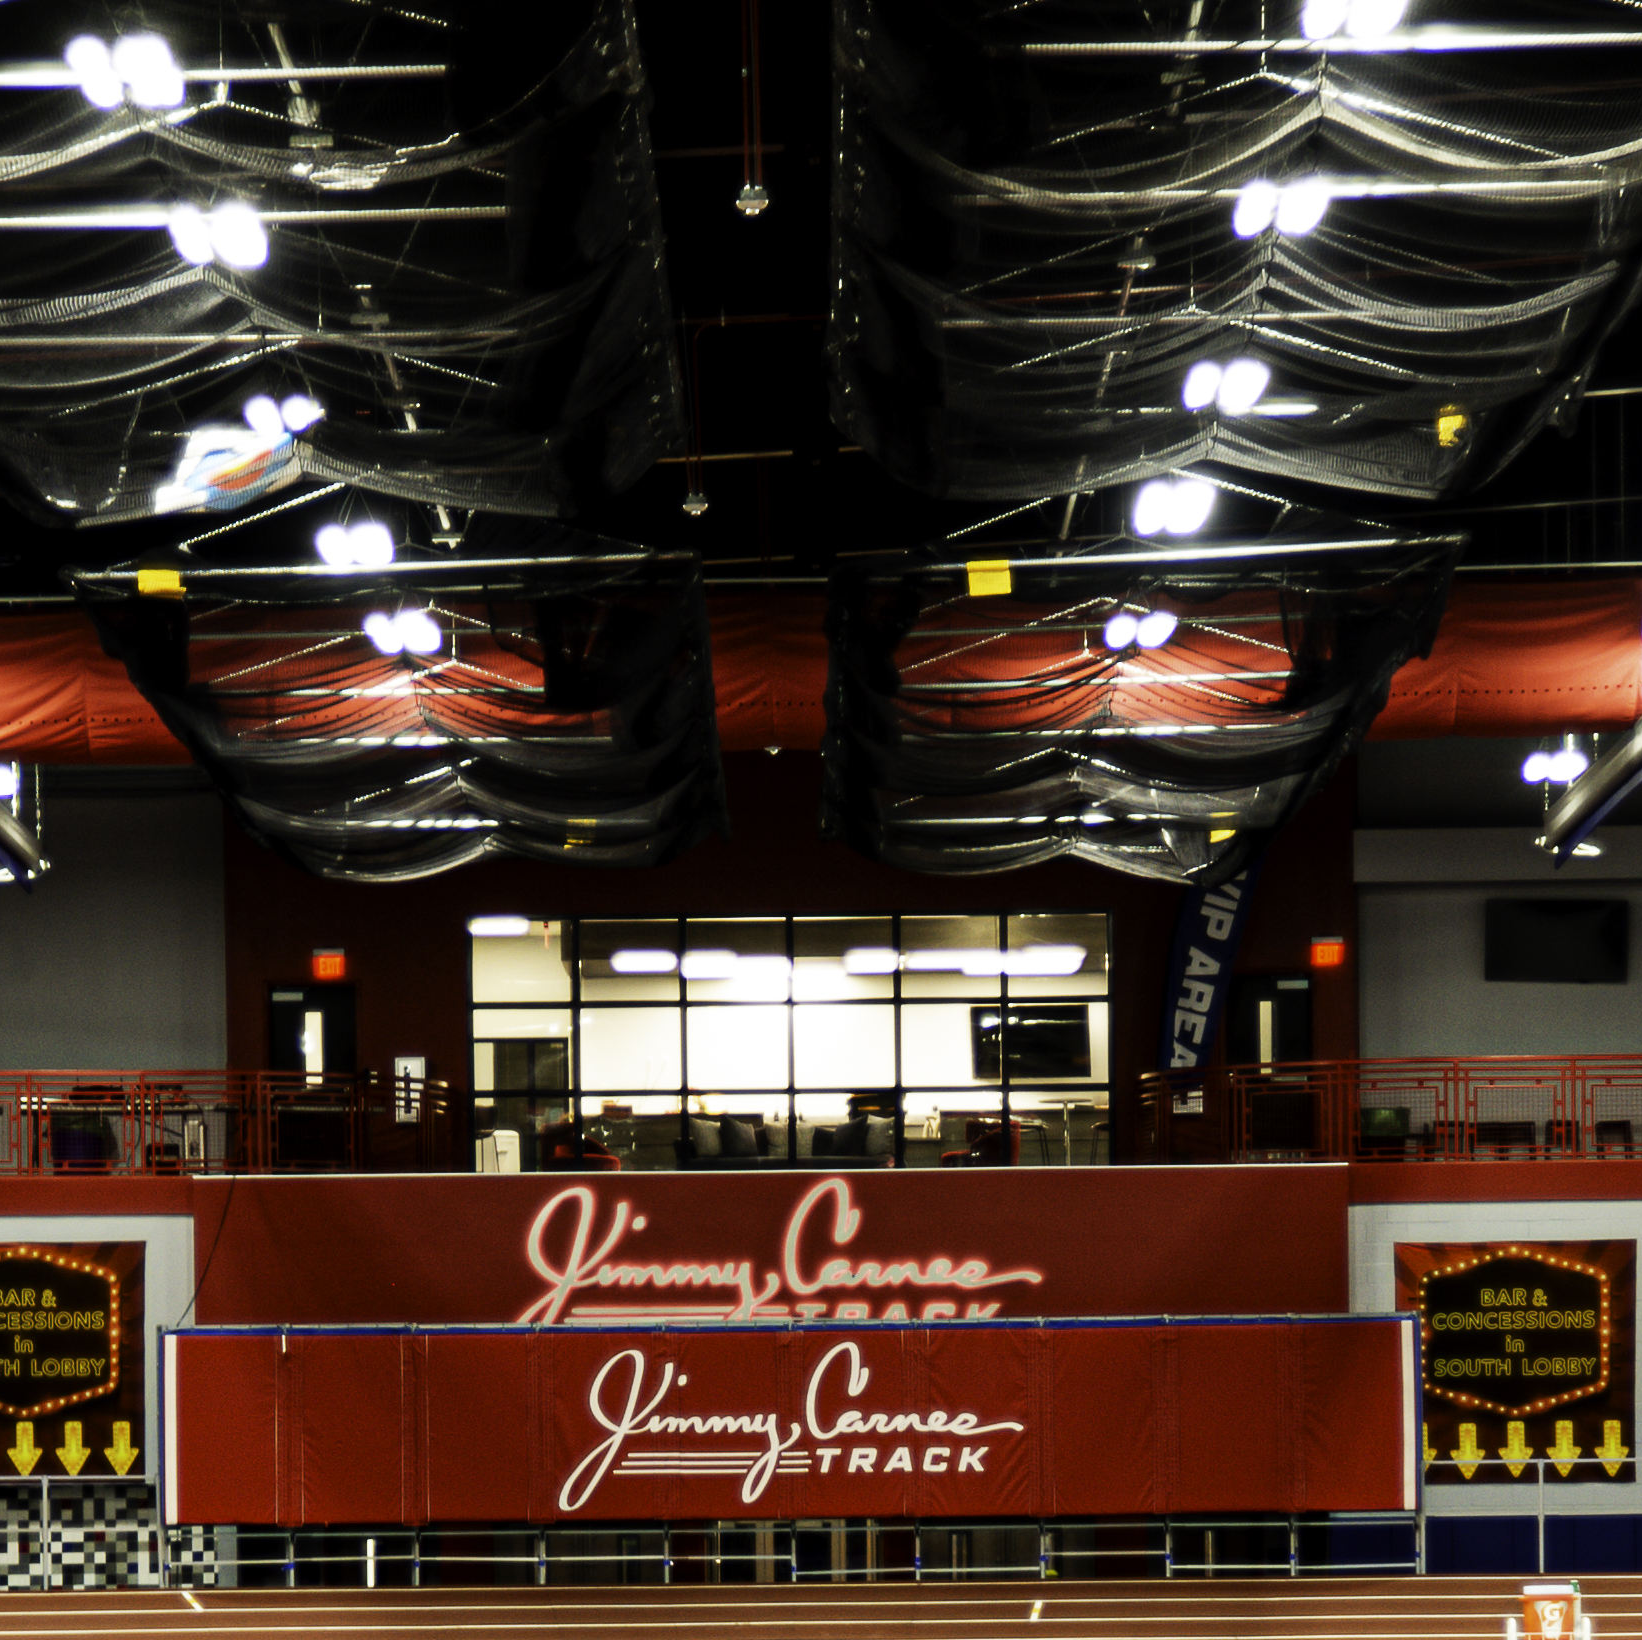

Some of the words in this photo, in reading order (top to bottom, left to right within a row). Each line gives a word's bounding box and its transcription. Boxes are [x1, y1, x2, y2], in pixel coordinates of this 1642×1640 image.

[1317, 945, 1339, 963] EXIT
[320, 957, 341, 974] EXIT
[1170, 945, 1221, 1068] AREA
[519, 1184, 780, 1324] Jimmy
[41, 1288, 57, 1308] &
[1480, 1287, 1528, 1308] BAR
[1532, 1287, 1548, 1308] &
[1432, 1309, 1596, 1331] CONCESSIONS
[13, 1334, 33, 1354] in
[1505, 1335, 1525, 1354] in
[30, 1357, 106, 1378] LOBBY
[1433, 1357, 1512, 1378] SOUTH
[1521, 1356, 1597, 1377] LOBBY
[559, 1349, 803, 1512] Jimmy
[815, 1446, 991, 1473] TRACK
